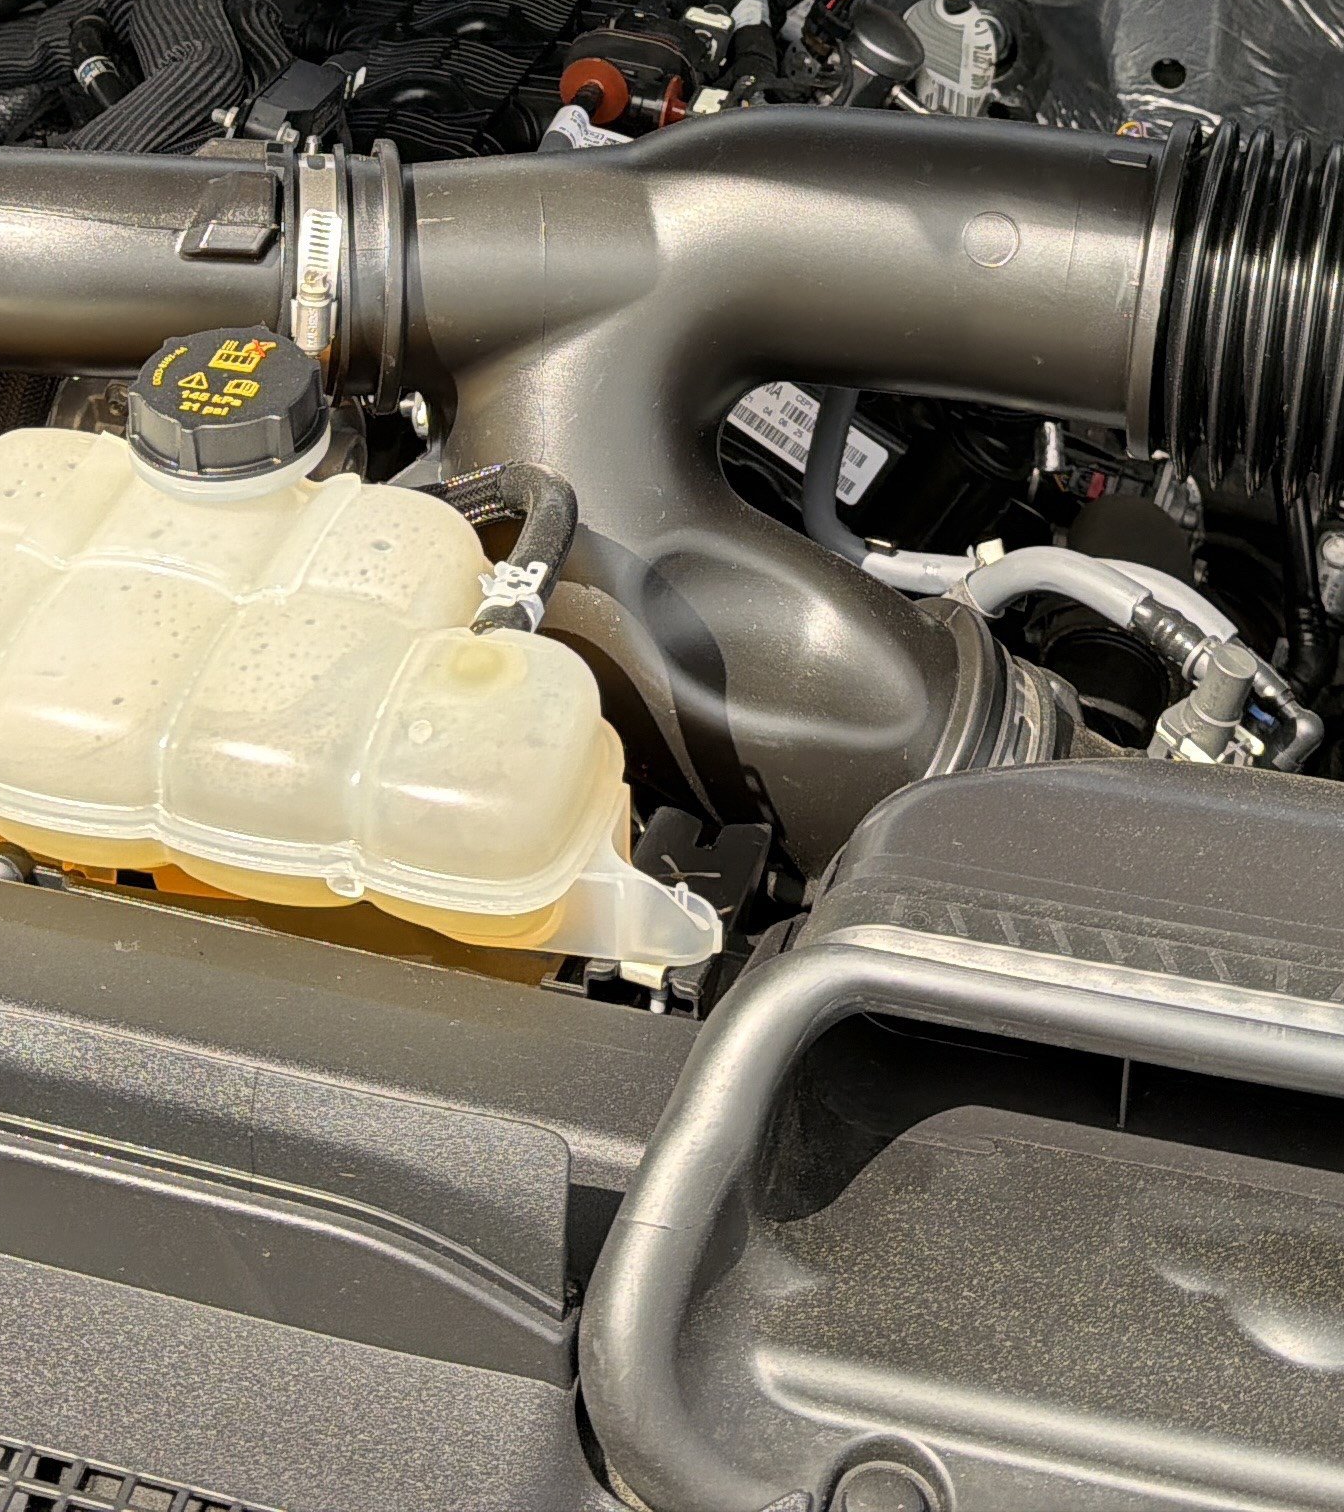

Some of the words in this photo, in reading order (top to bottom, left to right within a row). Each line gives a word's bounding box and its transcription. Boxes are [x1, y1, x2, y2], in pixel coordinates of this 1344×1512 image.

[211, 393, 243, 407] kPa
[179, 401, 201, 412] 21
[201, 405, 230, 416] psi
[792, 428, 805, 439] 25
